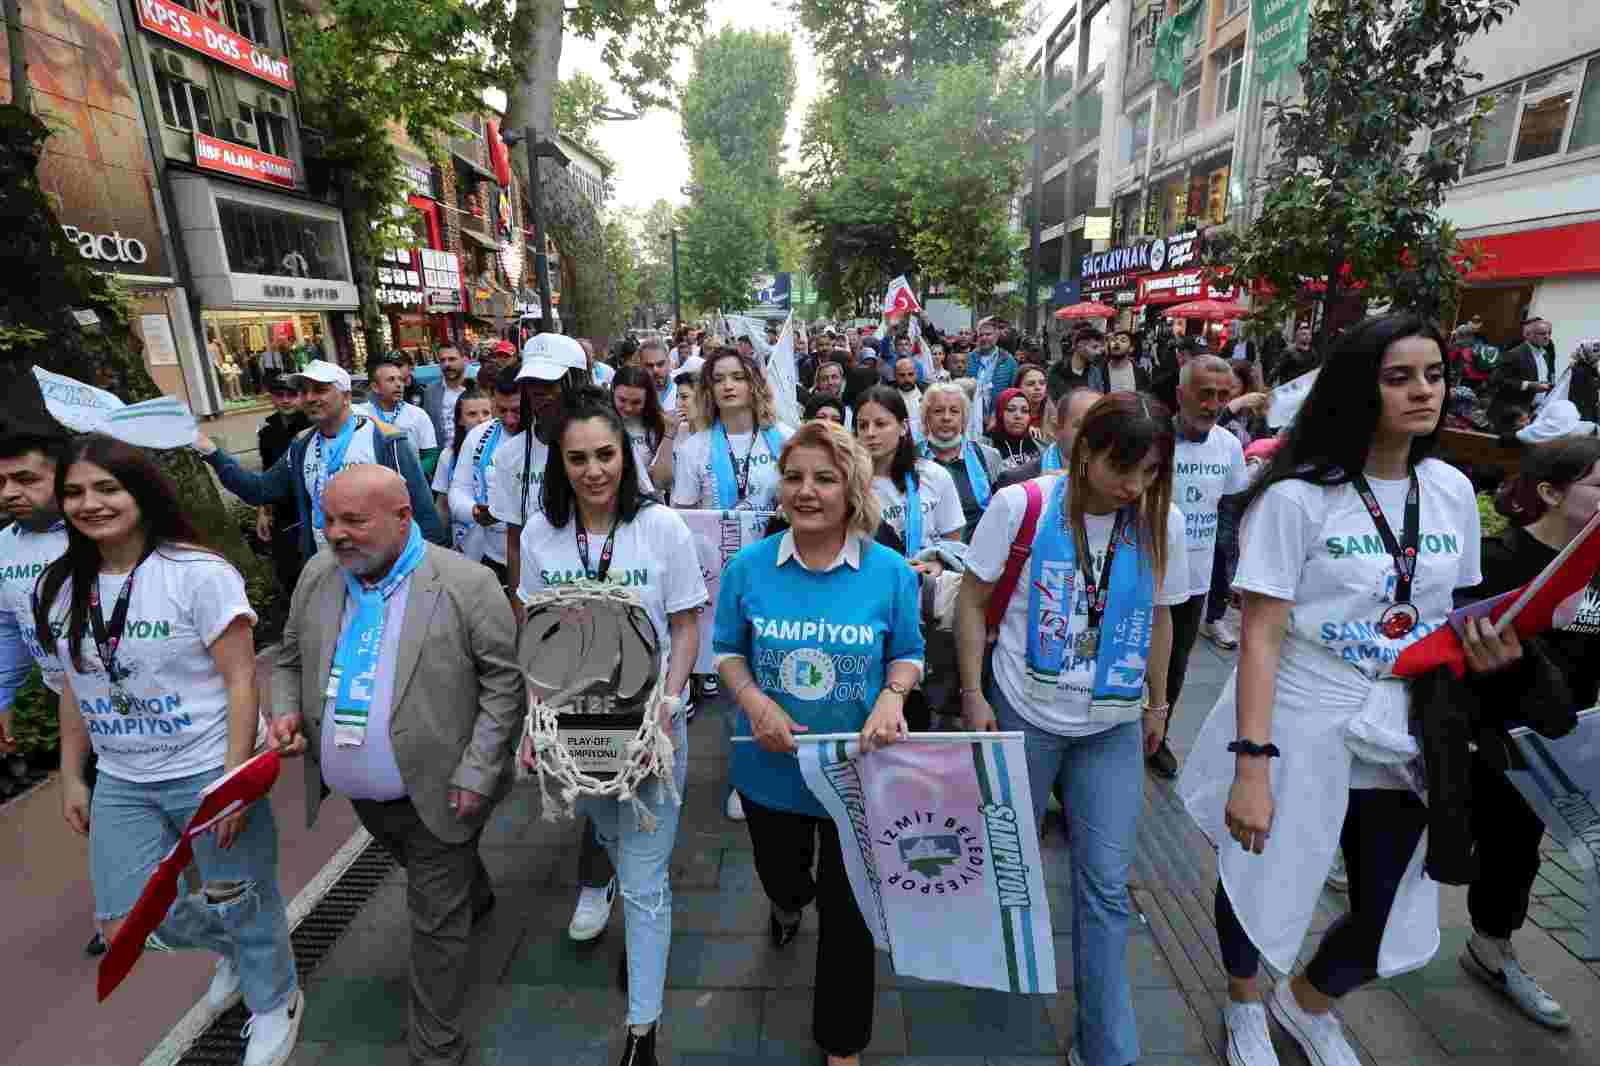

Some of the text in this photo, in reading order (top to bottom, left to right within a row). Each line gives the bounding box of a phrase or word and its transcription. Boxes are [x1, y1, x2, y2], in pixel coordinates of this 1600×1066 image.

[142, 0, 192, 37] KPSS
[203, 26, 240, 59] DGS
[567, 736, 612, 747] PLAY-OFF
[564, 748, 618, 759] AMPİYONU
